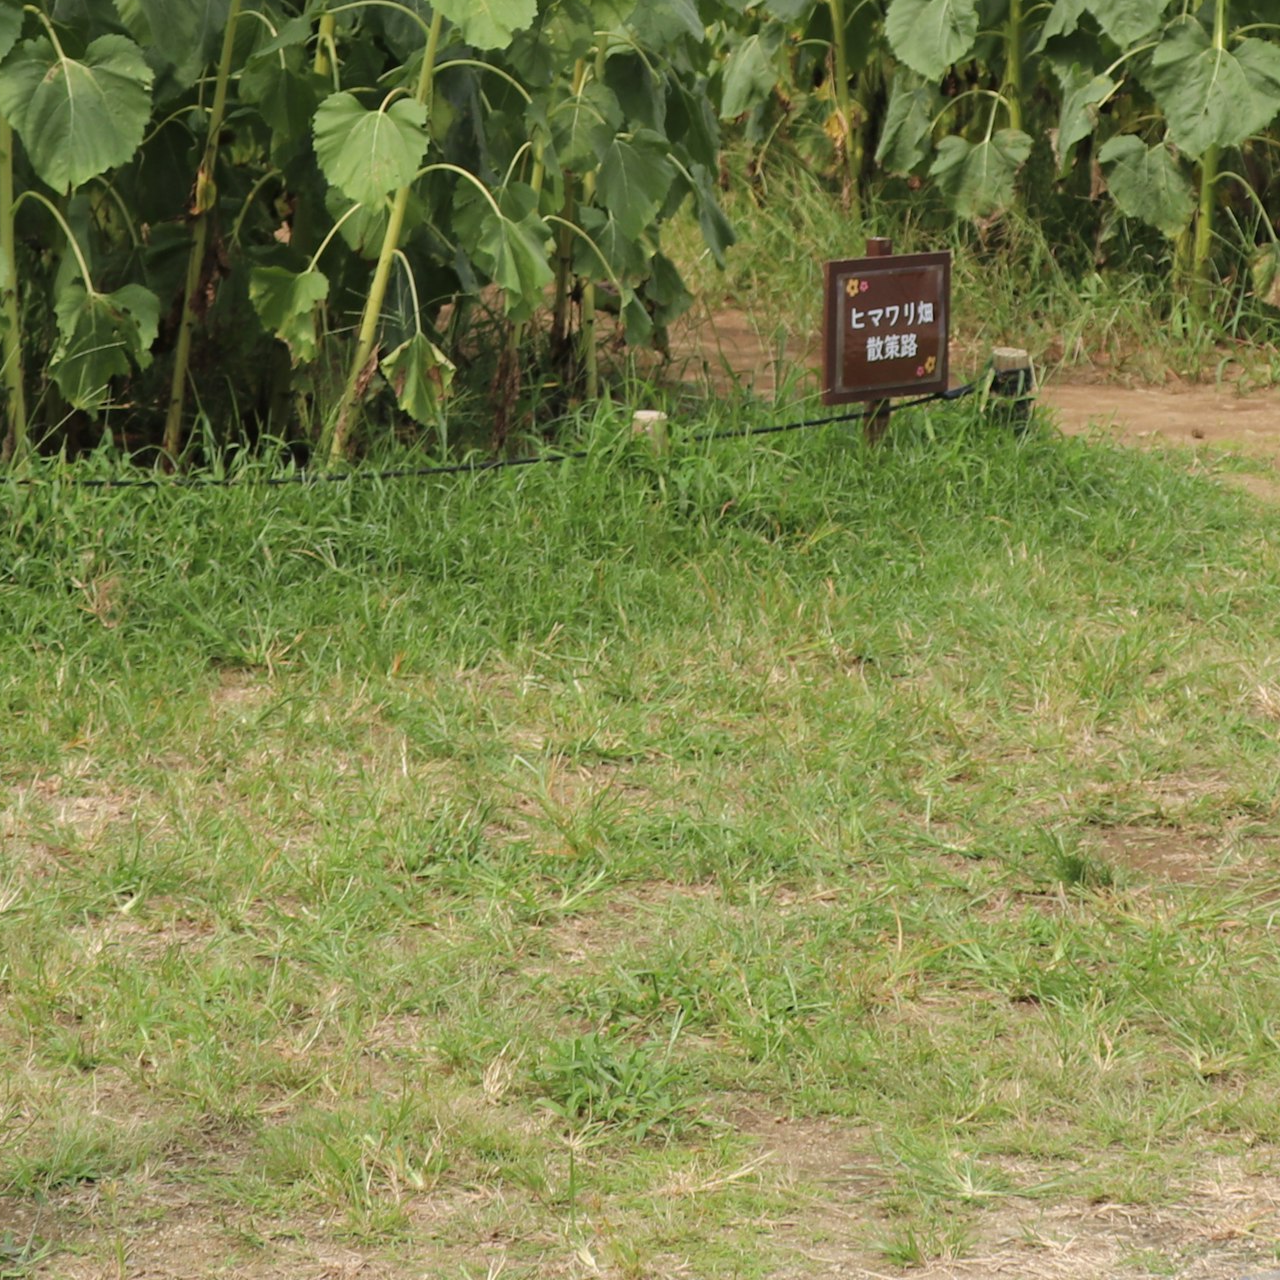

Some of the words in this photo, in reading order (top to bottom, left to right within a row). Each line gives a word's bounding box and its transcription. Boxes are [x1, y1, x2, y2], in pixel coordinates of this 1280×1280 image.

[851, 300, 934, 329] ヒマワリ畑
[866, 333, 918, 362] 散策路
